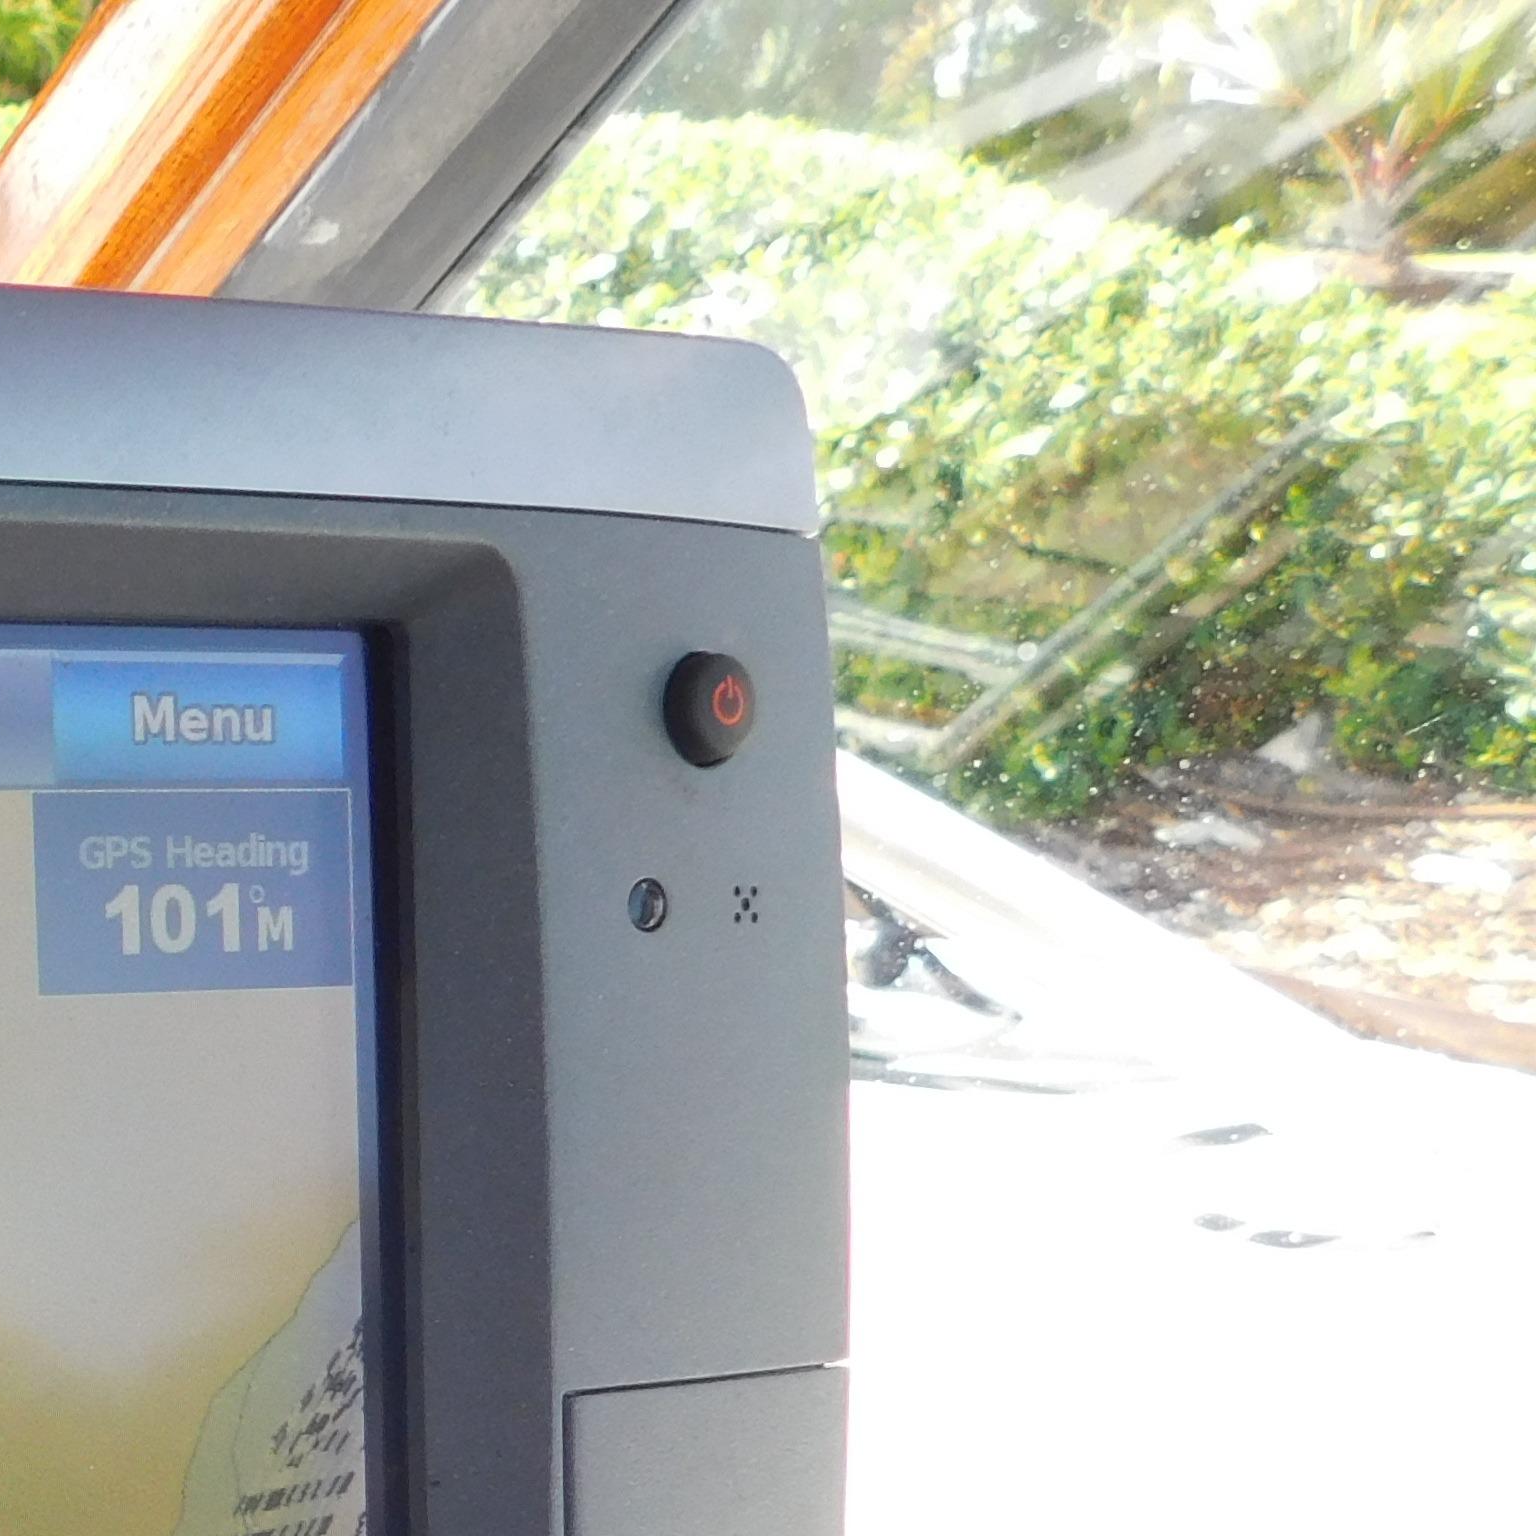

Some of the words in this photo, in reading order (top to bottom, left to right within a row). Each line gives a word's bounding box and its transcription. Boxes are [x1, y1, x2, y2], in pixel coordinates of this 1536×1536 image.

[131, 693, 275, 745] Menu
[79, 835, 153, 870] GPS
[166, 832, 310, 876] Heading
